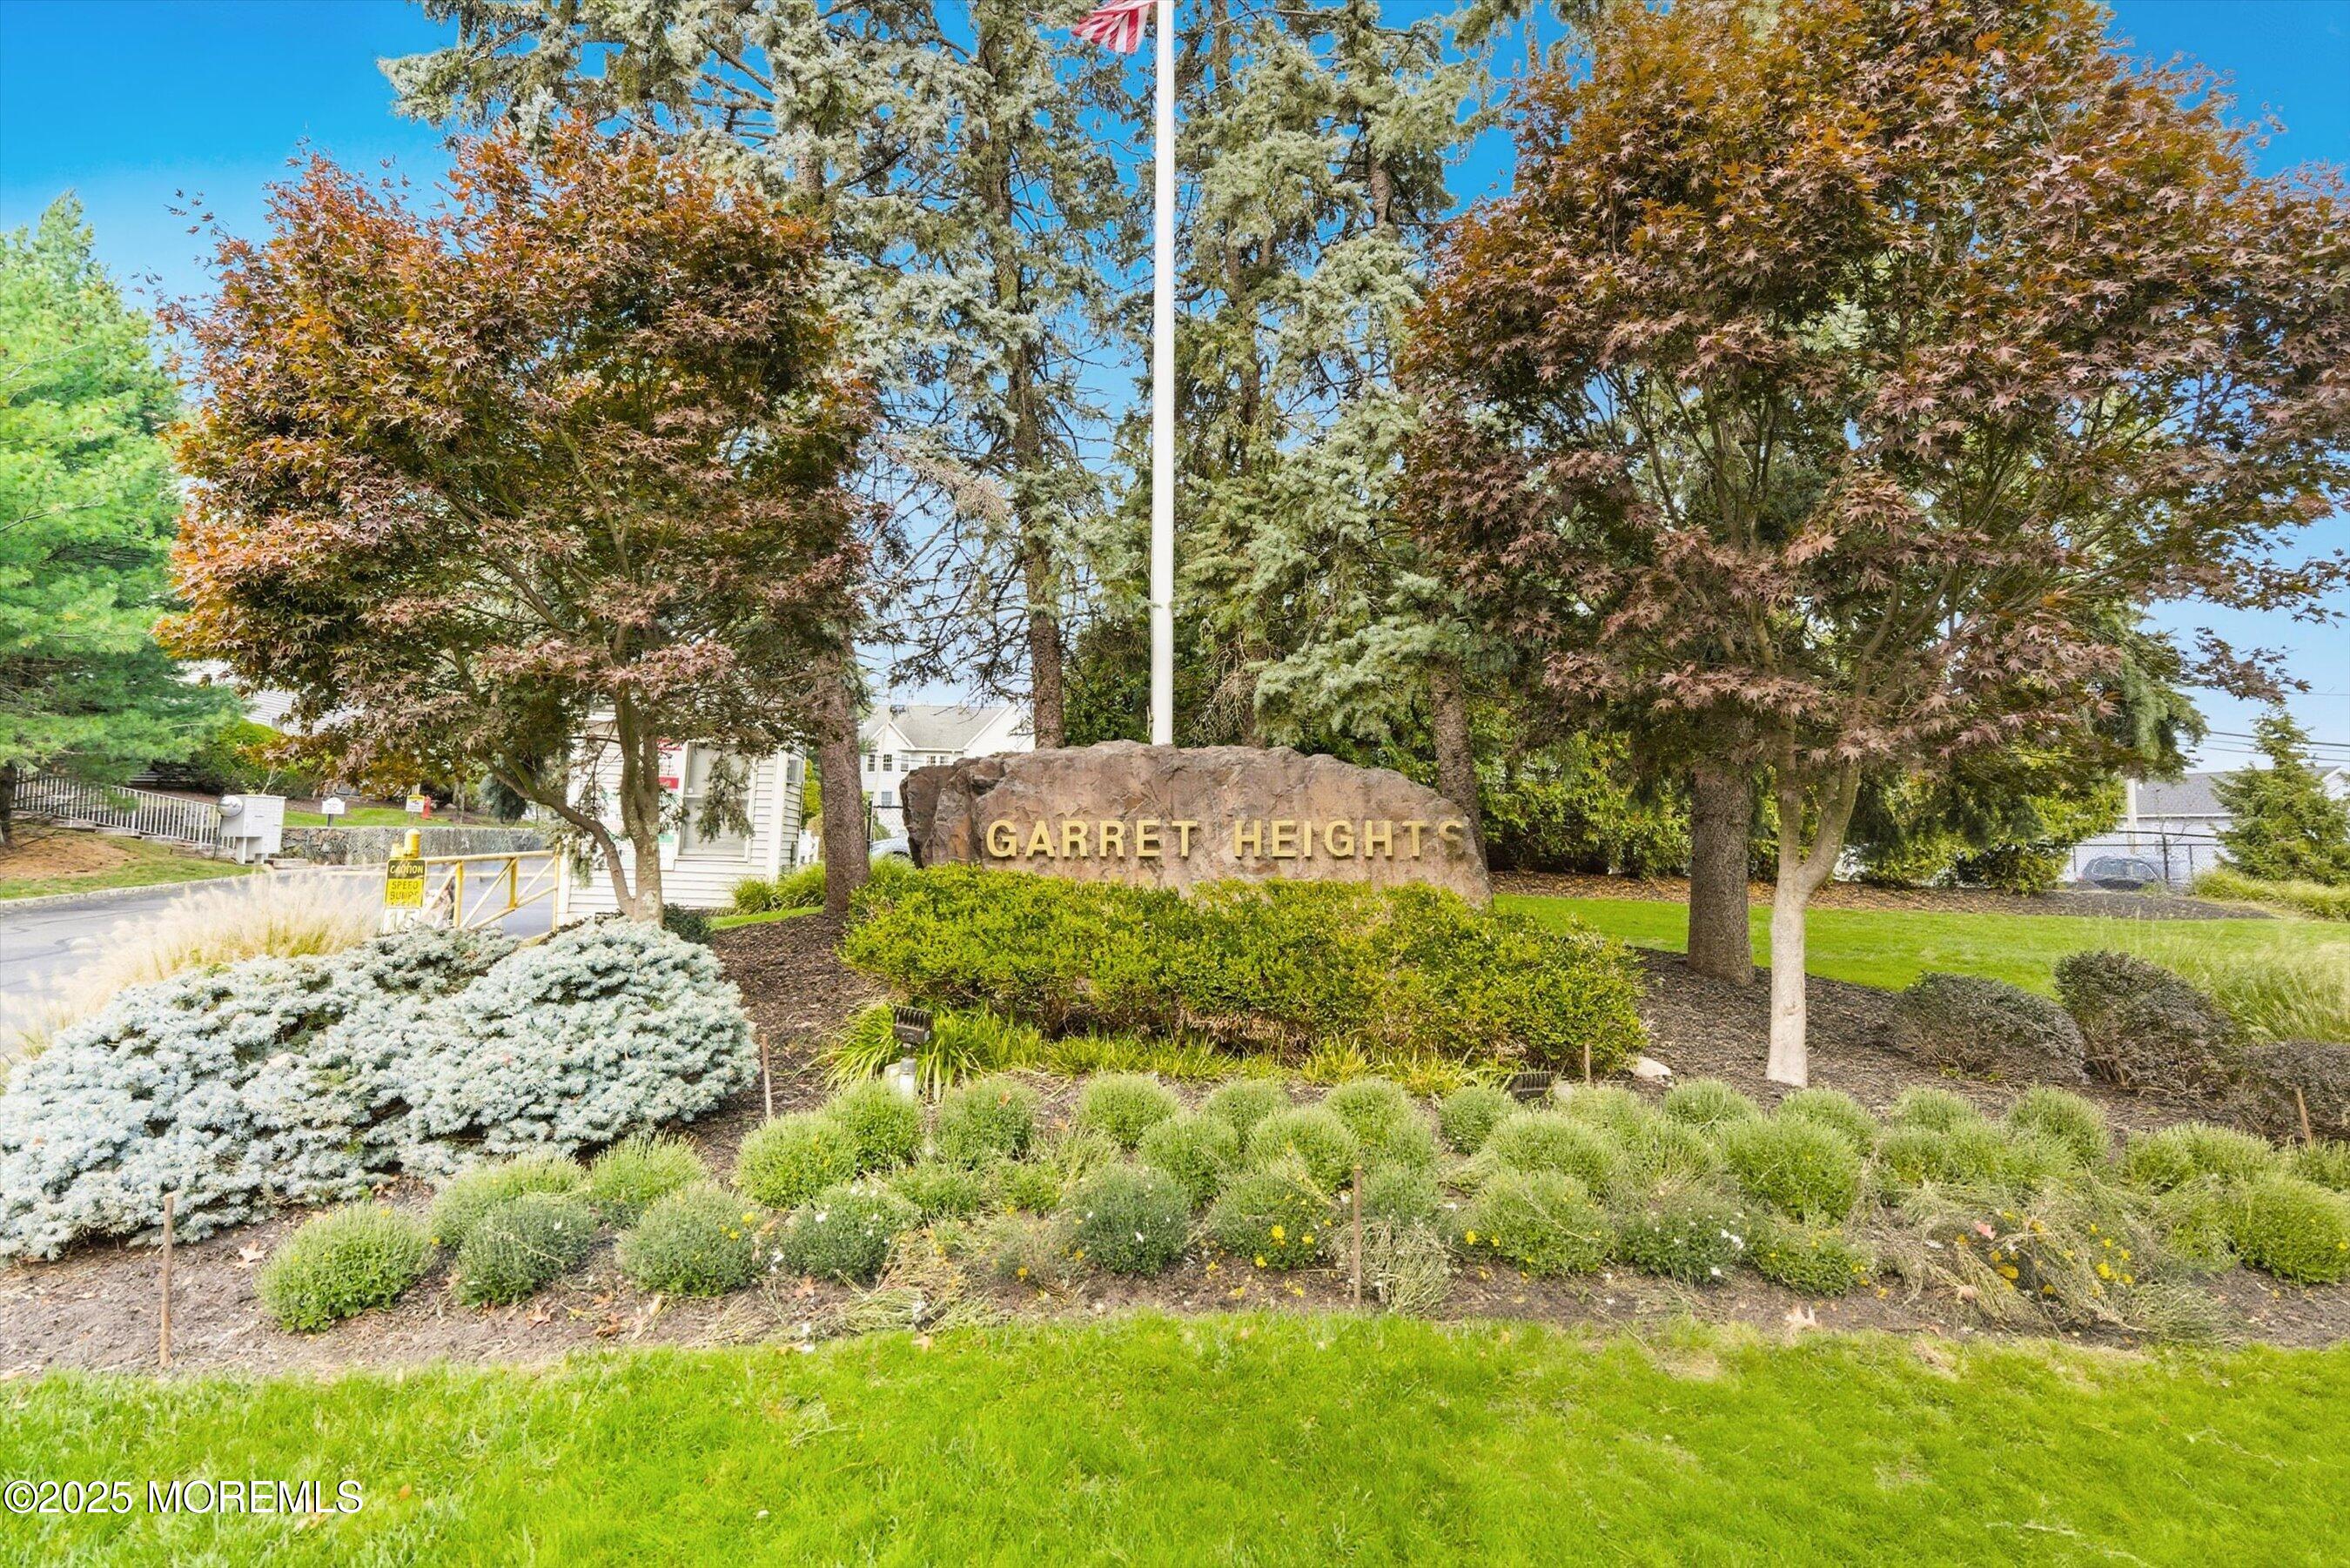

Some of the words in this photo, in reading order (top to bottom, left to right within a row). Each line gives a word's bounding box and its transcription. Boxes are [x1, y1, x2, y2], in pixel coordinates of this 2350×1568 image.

[986, 820, 1198, 857] GARRET
[1233, 819, 1464, 857] HEIGHTS
[392, 881, 419, 890] SPEED
